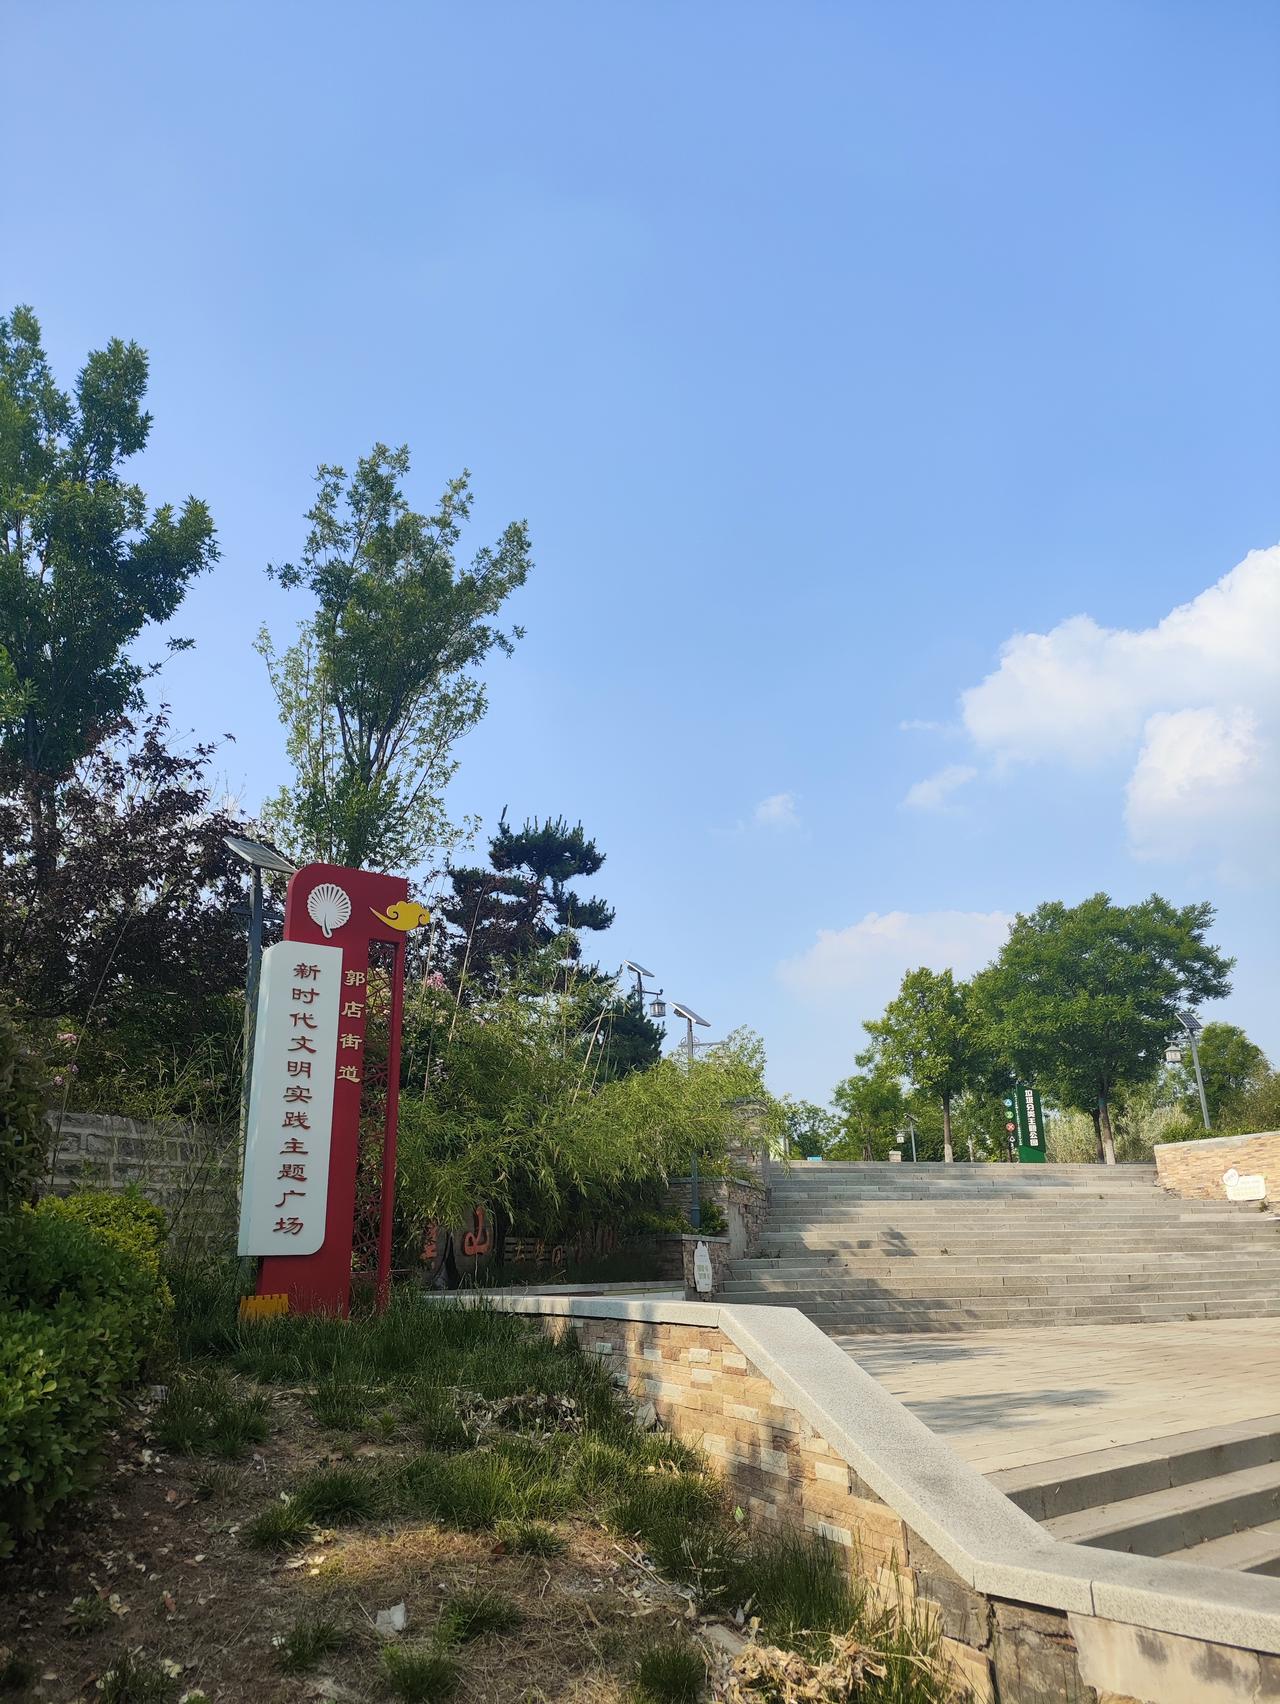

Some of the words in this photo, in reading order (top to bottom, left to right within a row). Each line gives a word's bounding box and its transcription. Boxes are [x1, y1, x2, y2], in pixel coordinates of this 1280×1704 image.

[272, 961, 322, 1237] 新时代文明实践主题广场
[336, 968, 366, 1084] 郭店街道
